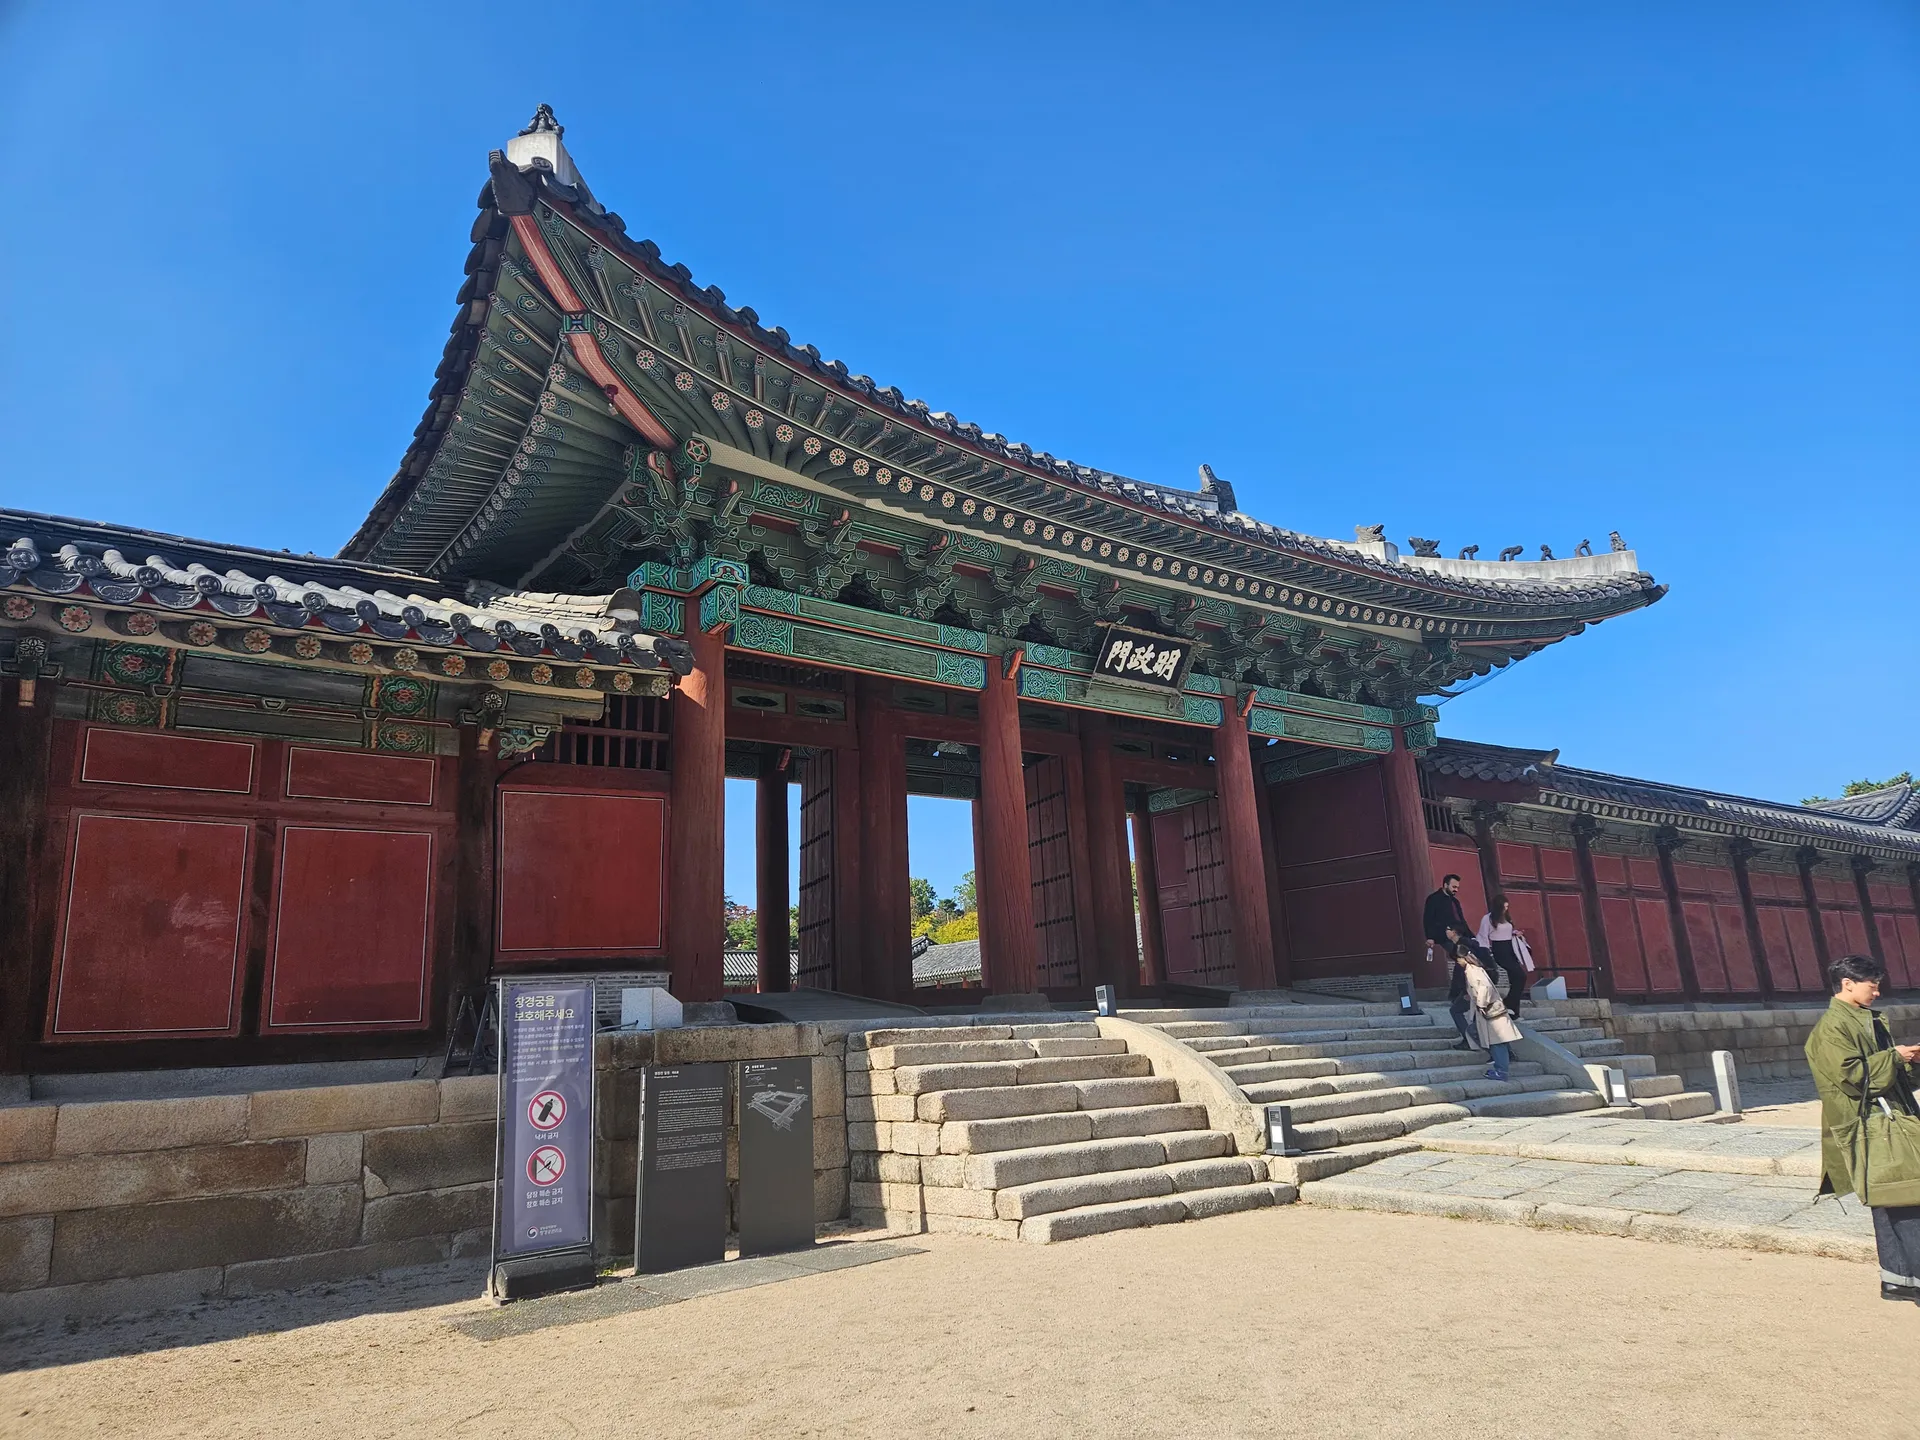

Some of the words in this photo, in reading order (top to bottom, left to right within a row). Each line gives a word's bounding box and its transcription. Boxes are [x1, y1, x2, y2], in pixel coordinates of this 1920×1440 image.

[515, 995, 555, 1008] 창경궁을
[514, 1008, 574, 1021] 보호해주세요
[745, 1065, 750, 1073] 2
[547, 1132, 559, 1140] 금지
[526, 1191, 538, 1199] 담장
[551, 1187, 563, 1195] 금지
[551, 1197, 563, 1205] 금지
